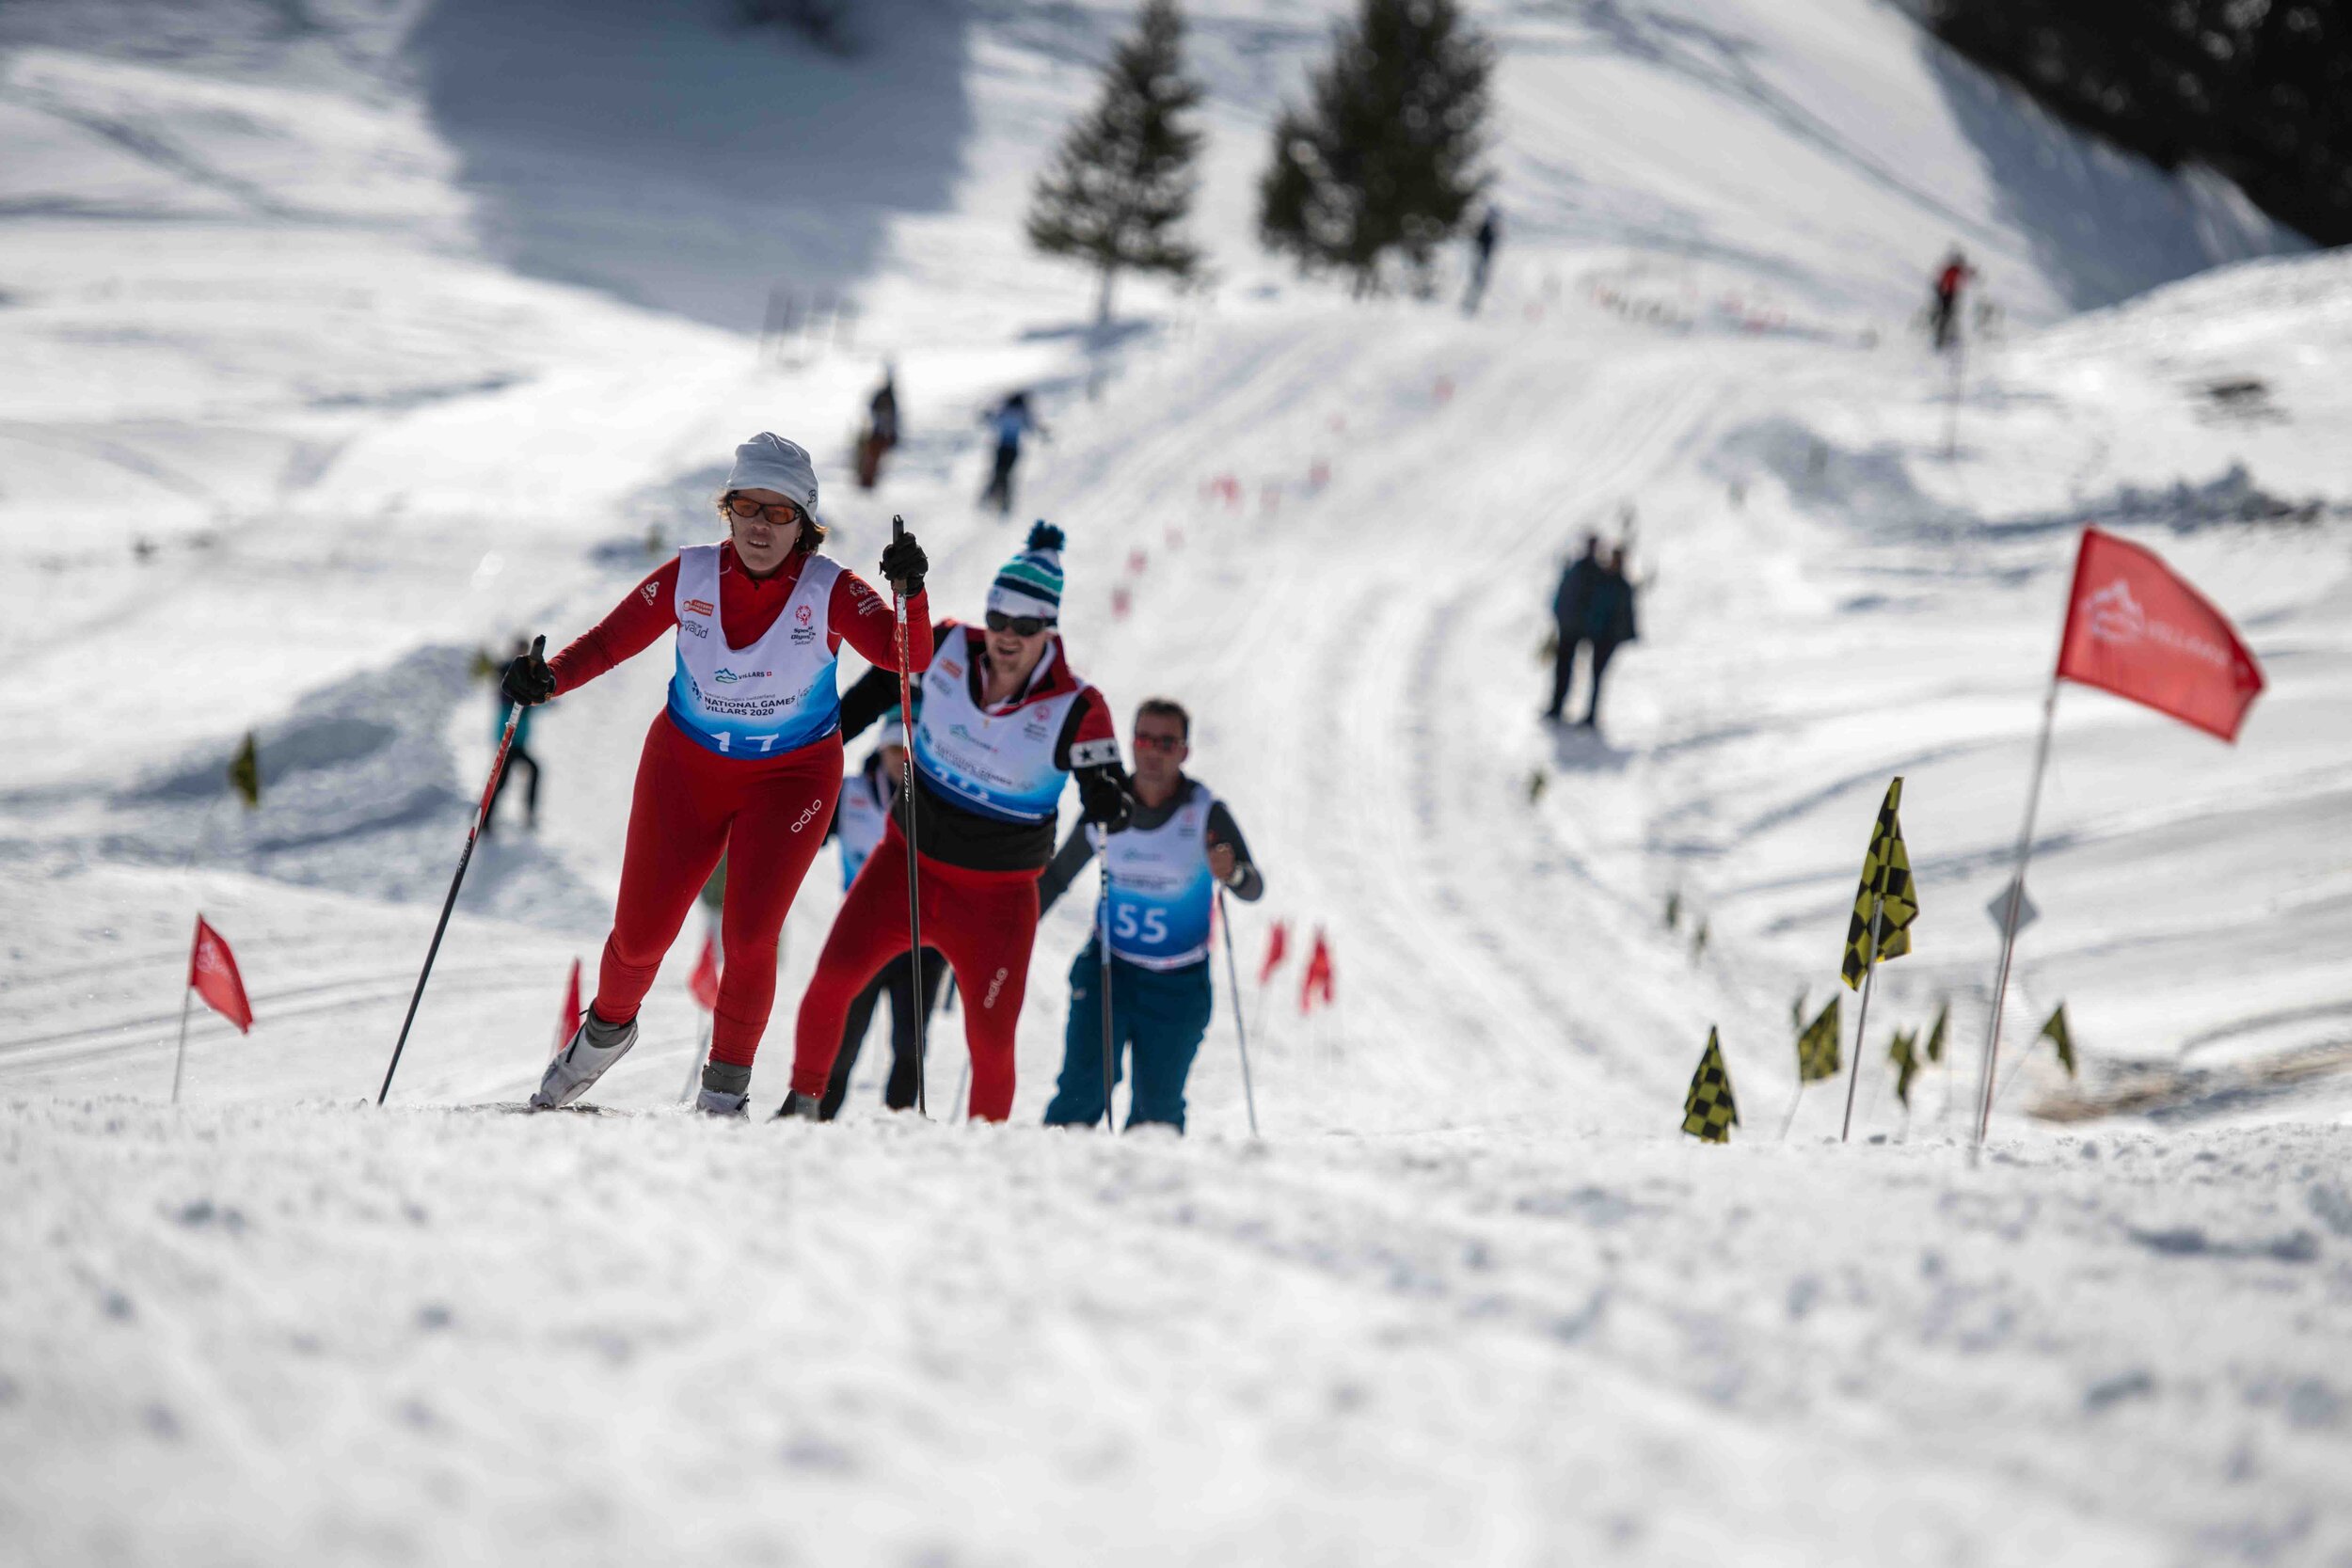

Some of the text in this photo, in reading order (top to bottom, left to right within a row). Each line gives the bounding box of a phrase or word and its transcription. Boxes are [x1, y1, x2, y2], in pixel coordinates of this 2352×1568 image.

[738, 671, 765, 680] VILLARS
[704, 695, 796, 708] NATIONAL GAMES
[705, 704, 774, 716] VILLARS 2020
[790, 799, 822, 833] odlo
[1113, 903, 1168, 944] 55
[983, 967, 1009, 1009] odlo
